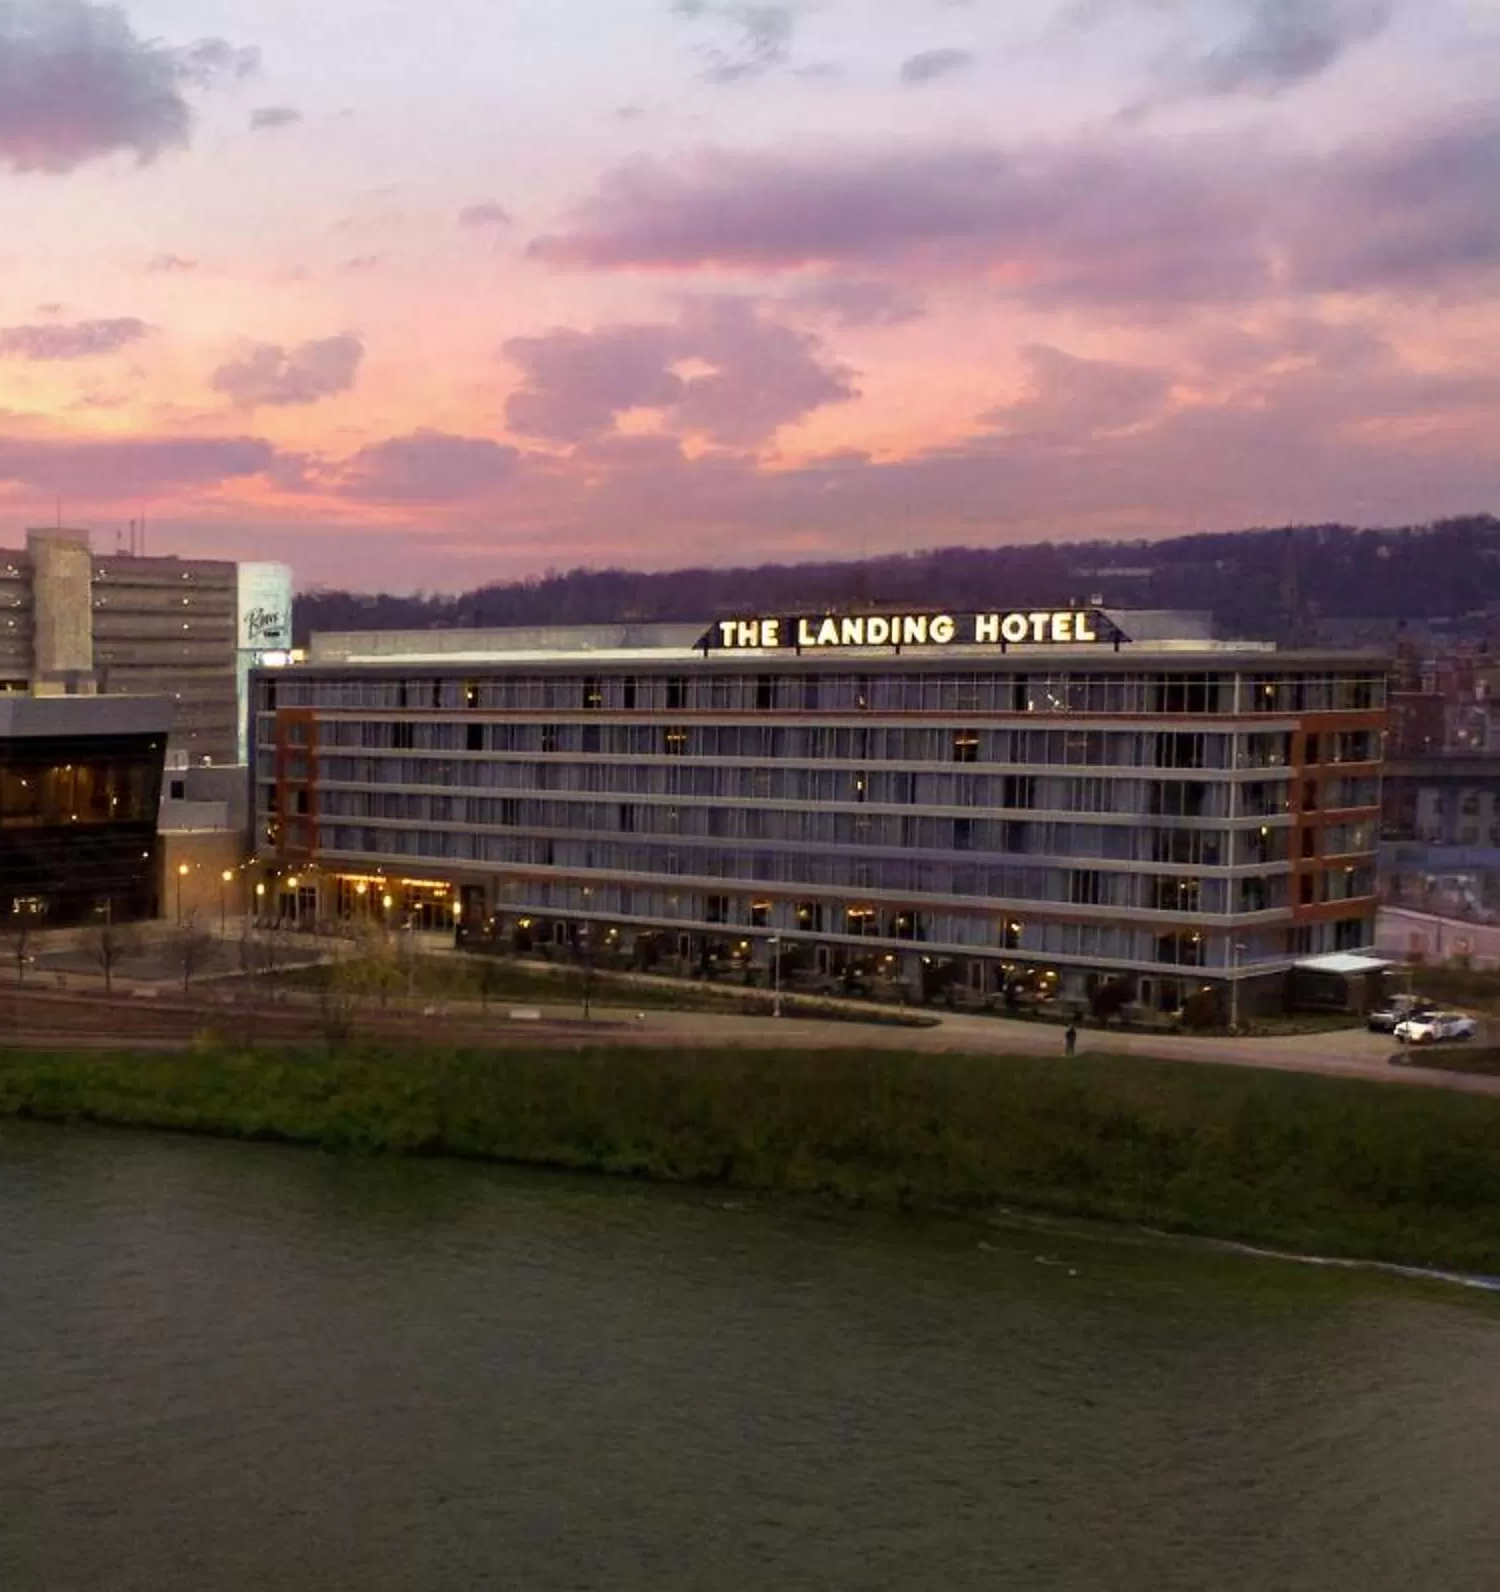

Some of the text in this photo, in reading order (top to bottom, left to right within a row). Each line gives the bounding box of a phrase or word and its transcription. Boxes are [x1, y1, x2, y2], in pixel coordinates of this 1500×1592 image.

[719, 612, 1096, 647] THE LANDING HOTEL
